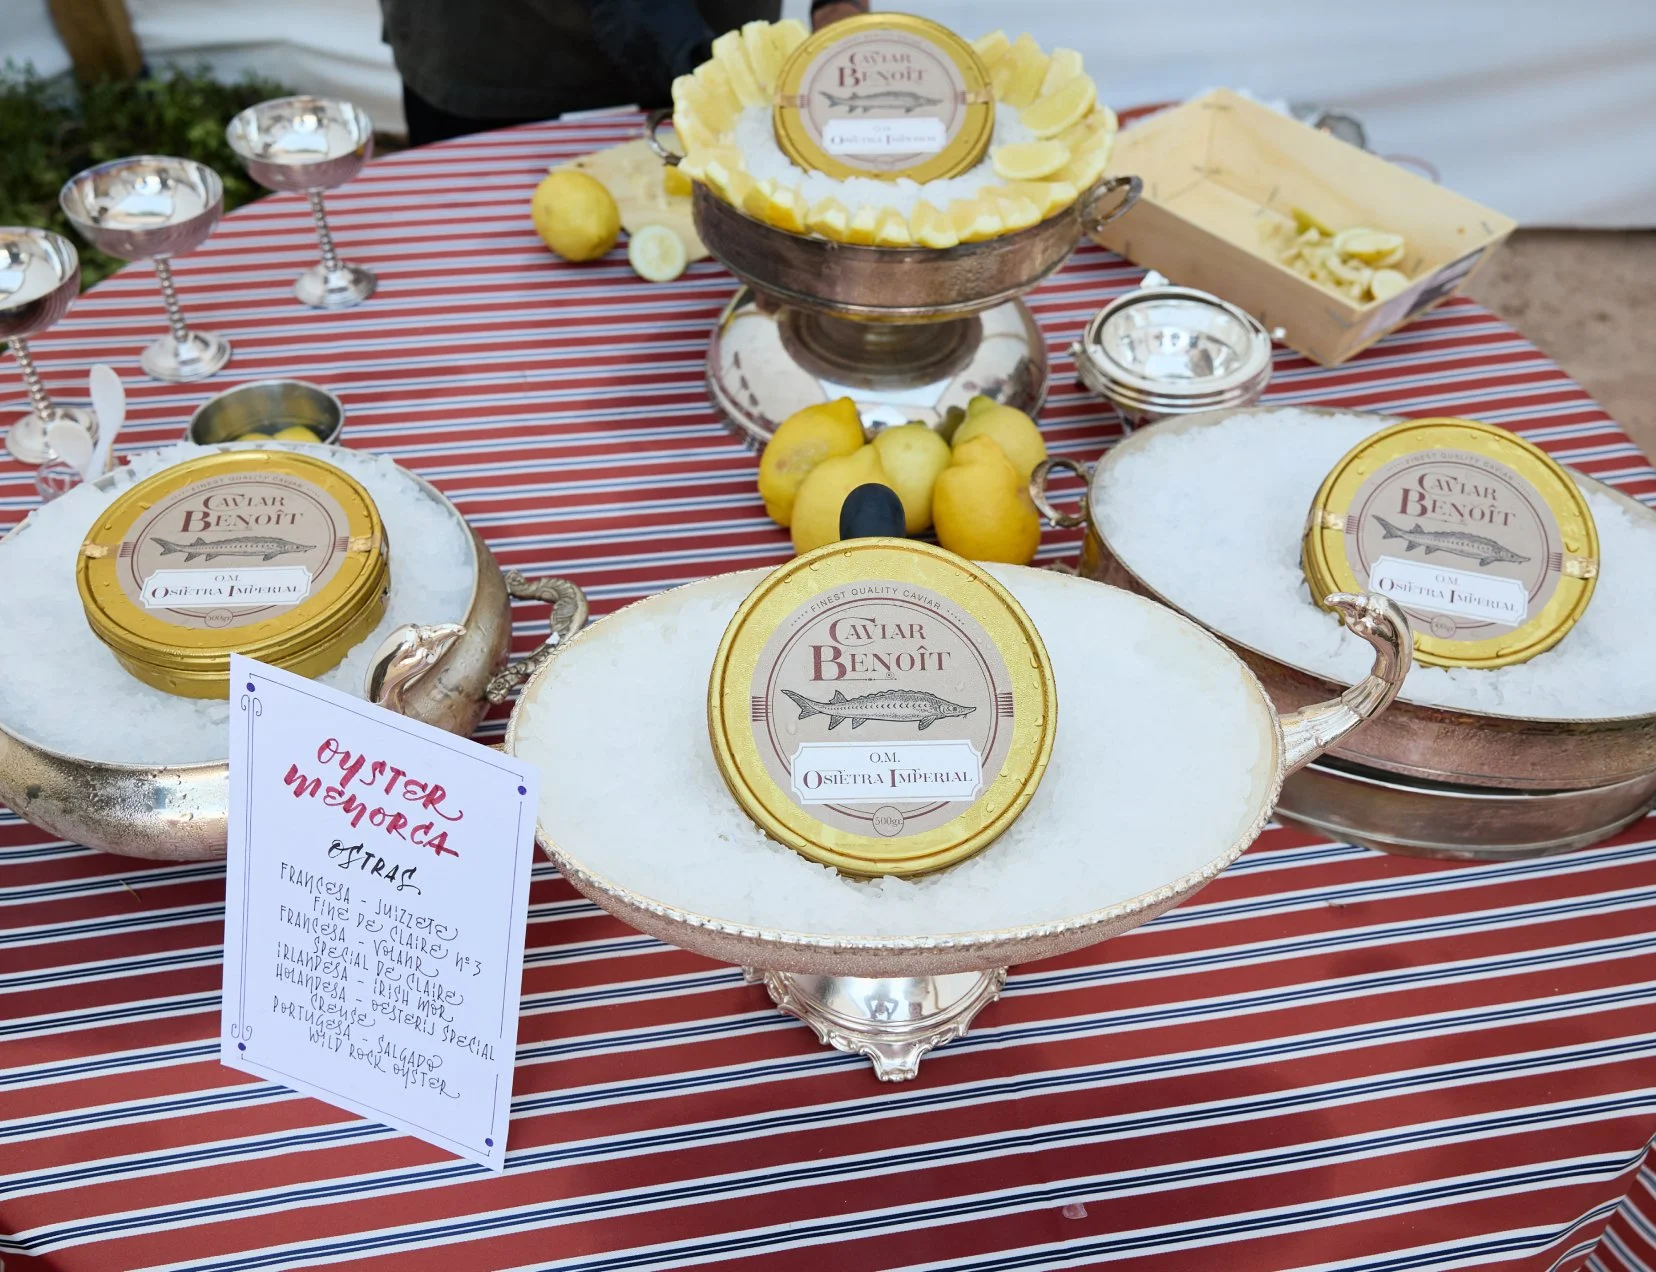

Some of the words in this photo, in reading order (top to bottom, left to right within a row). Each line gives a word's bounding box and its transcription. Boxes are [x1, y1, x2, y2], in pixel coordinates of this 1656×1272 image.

[849, 51, 912, 64] CAVIAR
[1440, 451, 1480, 464] QUALITY
[202, 492, 286, 512] CAVIAR
[1418, 472, 1498, 501] CAVIAR
[179, 508, 304, 533] BENOÎT
[1397, 487, 1516, 527] BENOÎT
[228, 584, 301, 597] IMPERIAL
[810, 590, 847, 613] FINEST
[851, 586, 899, 596] QUALITY
[903, 589, 942, 611] CAVIAR
[1449, 589, 1519, 613] IMPERIAL
[829, 616, 927, 647] CAVIAR
[809, 644, 951, 681] BENOÎT
[869, 751, 901, 763] O.M.
[317, 737, 464, 822] OYSTER
[889, 768, 973, 788] IMPERIAL
[283, 763, 460, 859] MENORCA
[280, 862, 350, 904] FRANCESA
[327, 839, 422, 896] OSTRAS
[280, 905, 346, 943] FRANCESA
[313, 896, 350, 921] FINE
[357, 913, 384, 932] DE
[390, 925, 449, 960] CLAIRE
[277, 941, 348, 982] IRLANDESA
[374, 978, 409, 1007] IRISH
[313, 936, 369, 971] SPECIAL
[377, 960, 402, 981] DE
[406, 973, 464, 1006] CLAIRE
[276, 963, 346, 1003] HOLANDESA
[442, 1025, 495, 1061] SPECIAL
[311, 992, 376, 1027] CREUSE
[273, 995, 351, 1041] PORTUGESA
[377, 1034, 444, 1073] SALGADO
[308, 1026, 343, 1053] WILD
[349, 1043, 386, 1073] ROCK
[393, 1063, 461, 1099] OYSTER
